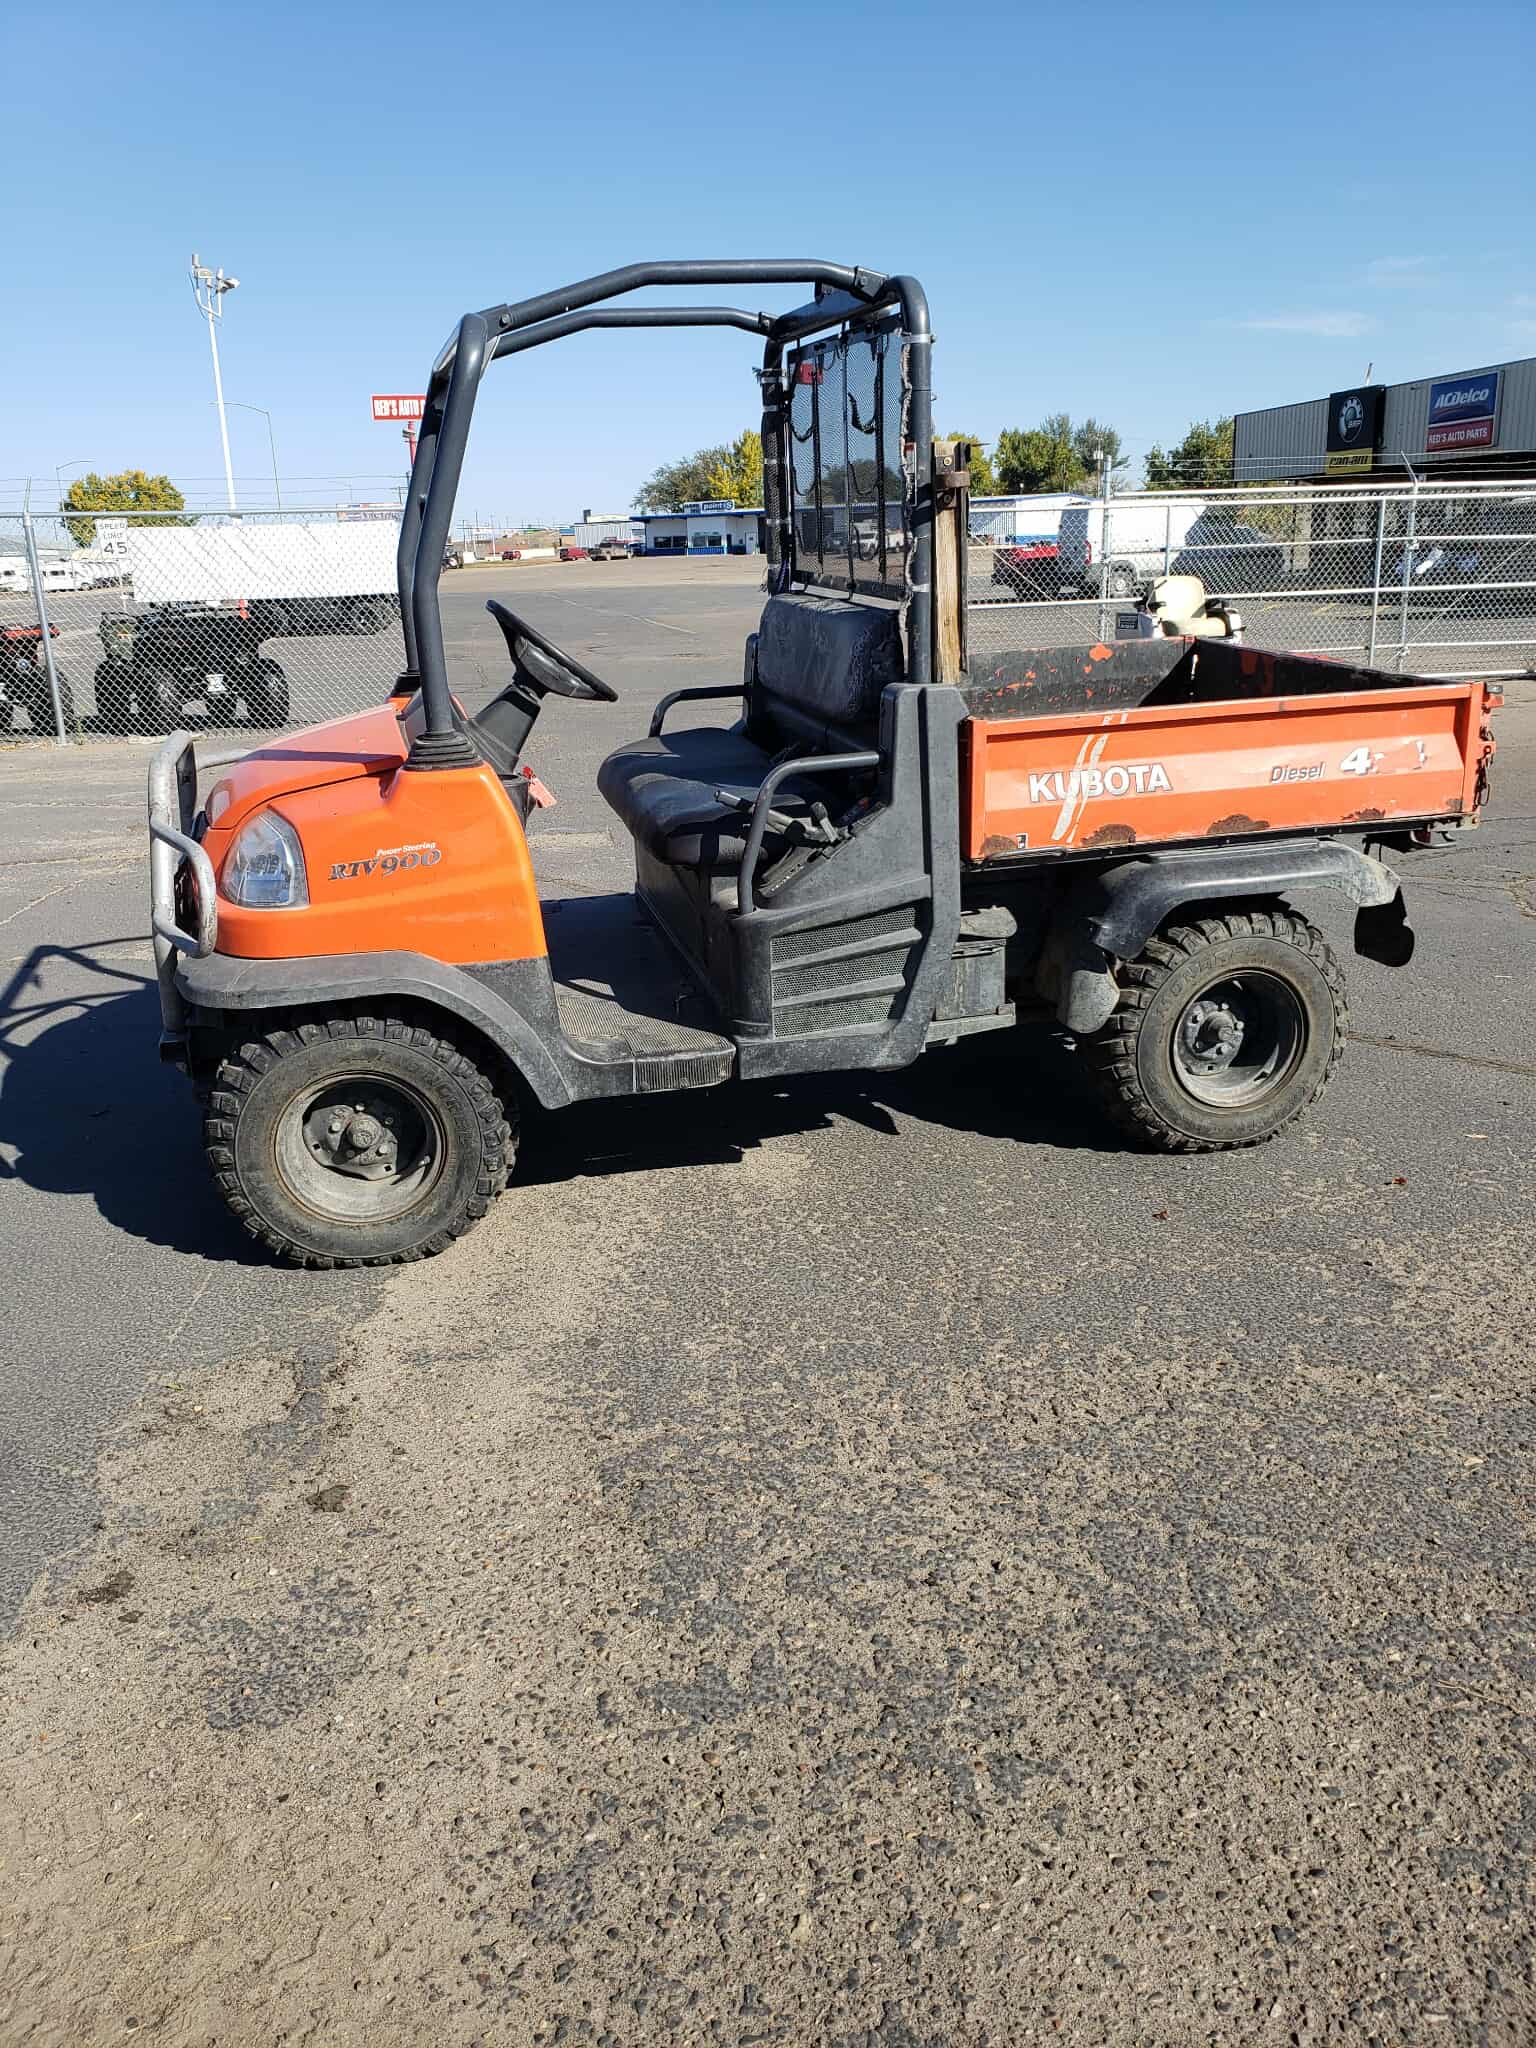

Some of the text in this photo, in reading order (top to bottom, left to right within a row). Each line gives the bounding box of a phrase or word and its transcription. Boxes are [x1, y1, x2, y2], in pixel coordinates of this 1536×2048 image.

[1434, 388, 1489, 409] ACDelco
[399, 400, 421, 416] AUTO
[1448, 430, 1465, 442] AUTO
[1466, 427, 1488, 440] PARTS
[104, 542, 128, 554] 45
[1270, 761, 1326, 784] Diesel
[1028, 762, 1174, 803] KUBOTA
[377, 841, 436, 857] Power Steering
